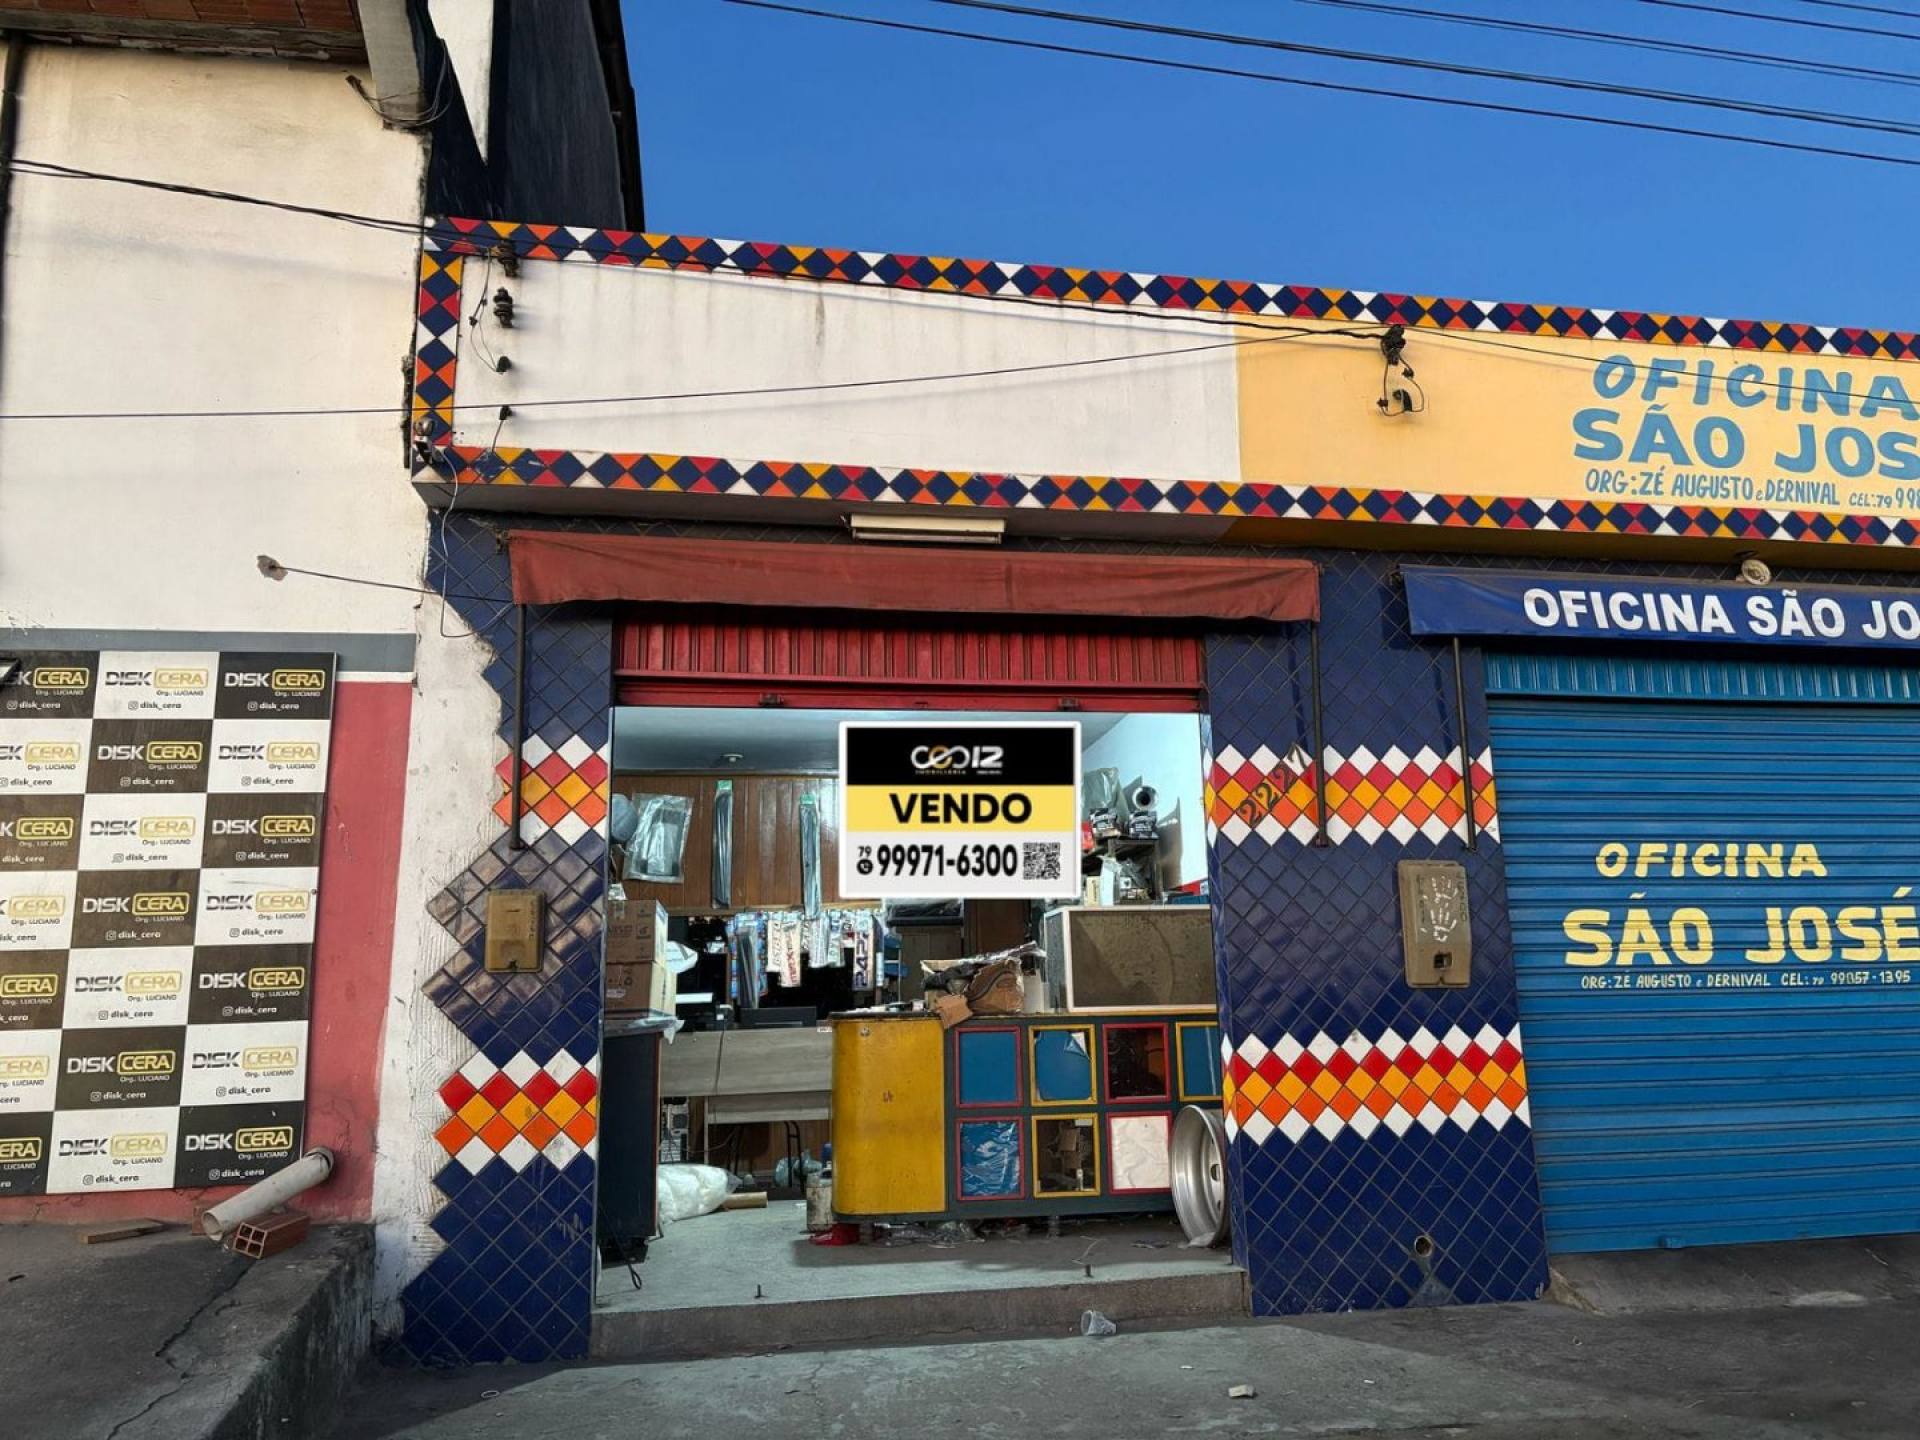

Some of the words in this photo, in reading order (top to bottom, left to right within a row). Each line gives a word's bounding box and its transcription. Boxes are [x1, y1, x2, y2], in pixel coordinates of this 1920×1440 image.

[1593, 354, 1920, 421] OFICINA
[1572, 403, 1746, 469] SÃO
[1671, 472, 1754, 499] AUGUSTO
[1765, 479, 1840, 505] DERNIVAL
[1523, 587, 1736, 634] OFICINA
[1748, 589, 1845, 638] SÃO
[1862, 600, 1920, 639] JO
[35, 671, 85, 685] CERA
[105, 671, 151, 685] DISK
[155, 672, 204, 685] CERA
[224, 673, 269, 686] DISK
[274, 673, 321, 687] CERA
[26, 745, 77, 759] CERA
[97, 746, 144, 759] DISK
[149, 745, 198, 759] CERA
[218, 745, 264, 759] DISK
[268, 745, 316, 759] CERA
[17, 821, 69, 836] CERA
[89, 820, 137, 835] DISK
[141, 820, 191, 834] CERA
[212, 820, 258, 834] DISK
[263, 819, 312, 833] CERA
[1596, 843, 1828, 878] OFICINA
[9, 898, 62, 914] CERA
[82, 897, 130, 913] DISK
[135, 896, 186, 912] CERA
[205, 895, 252, 910] DISK
[257, 894, 306, 909] CERA
[1563, 891, 1714, 966] SÃO
[1745, 886, 1920, 963] JOSÉ
[1, 978, 54, 994] CERA
[73, 976, 122, 992] DISK
[127, 974, 178, 990] CERA
[199, 973, 246, 988] DISK
[251, 971, 301, 987] CERA
[1636, 974, 1692, 988] AUGUSTO
[1707, 973, 1771, 987] DERNIVAL
[65, 1056, 115, 1073] DISK
[119, 1054, 172, 1071] CERA
[191, 1052, 239, 1068] DISK
[244, 1050, 295, 1066] CERA
[57, 1138, 108, 1156] DISK
[112, 1136, 165, 1153] CERA
[184, 1133, 233, 1151] DISK
[238, 1131, 289, 1148] CERA
